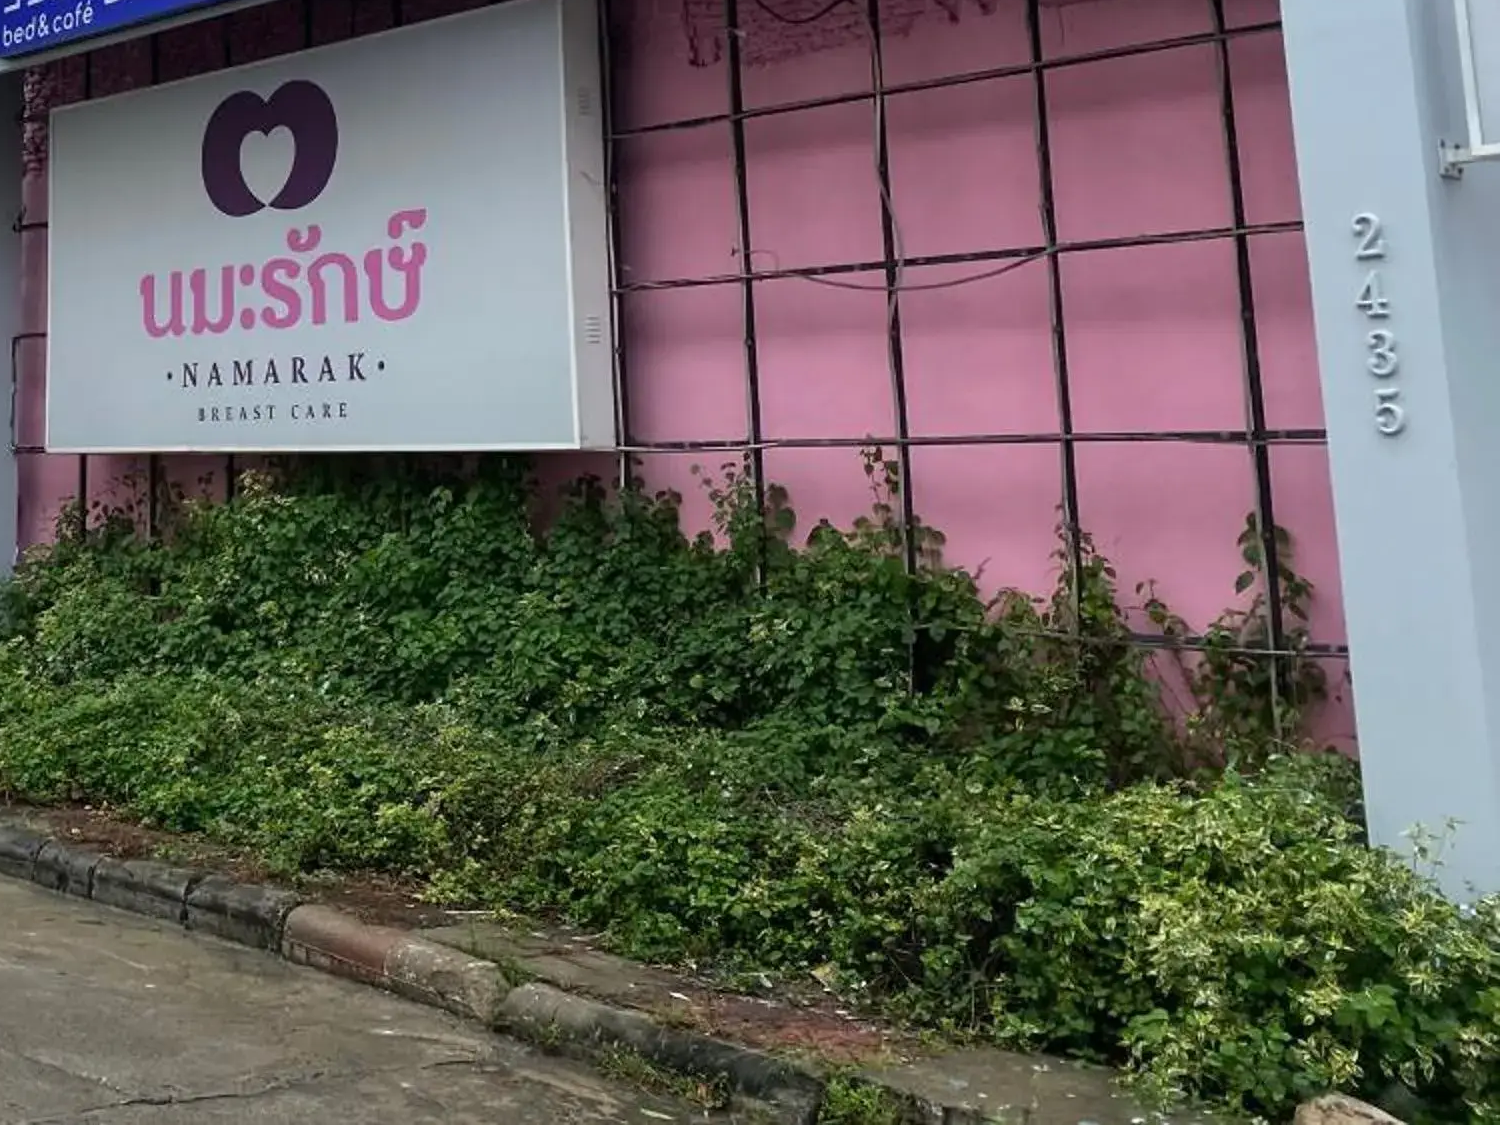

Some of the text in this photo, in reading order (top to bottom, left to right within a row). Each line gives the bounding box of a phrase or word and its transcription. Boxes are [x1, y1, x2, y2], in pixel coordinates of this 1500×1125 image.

[139, 208, 428, 338] นมะรักษ์
[197, 402, 348, 423] BREAST CARE
